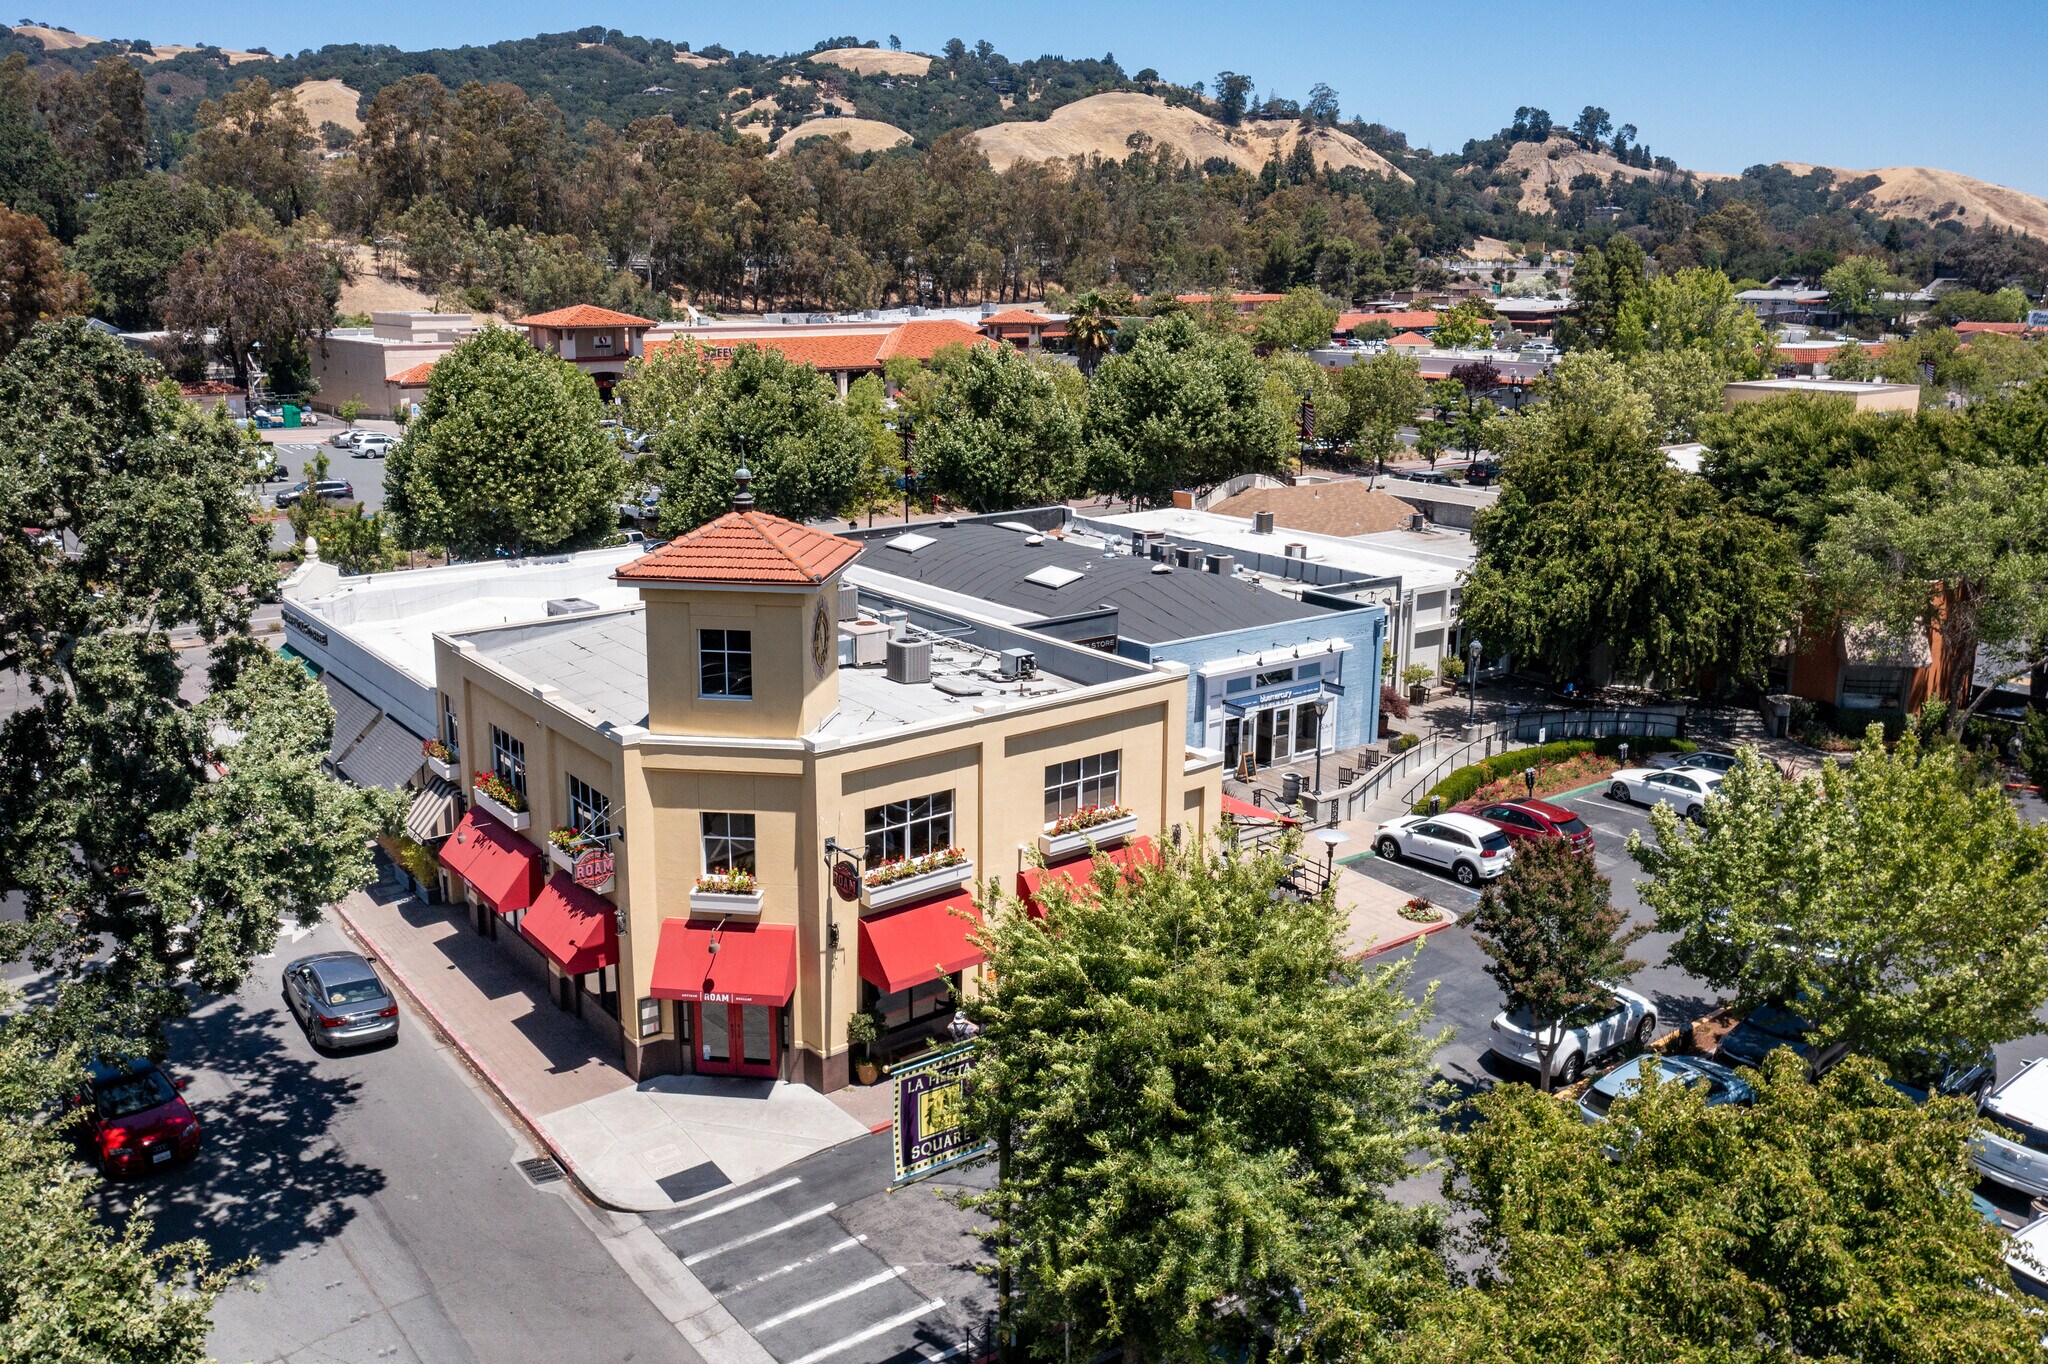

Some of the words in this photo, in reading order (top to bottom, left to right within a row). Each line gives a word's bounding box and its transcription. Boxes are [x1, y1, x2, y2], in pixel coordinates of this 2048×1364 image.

[1091, 639, 1115, 649] STORE
[1260, 691, 1292, 703] bluemercury
[576, 860, 614, 879] ROAM
[833, 870, 856, 893] ROAM
[703, 992, 730, 1002] ROAM
[907, 1078, 924, 1094] LA
[911, 1129, 971, 1160] SQUARE
